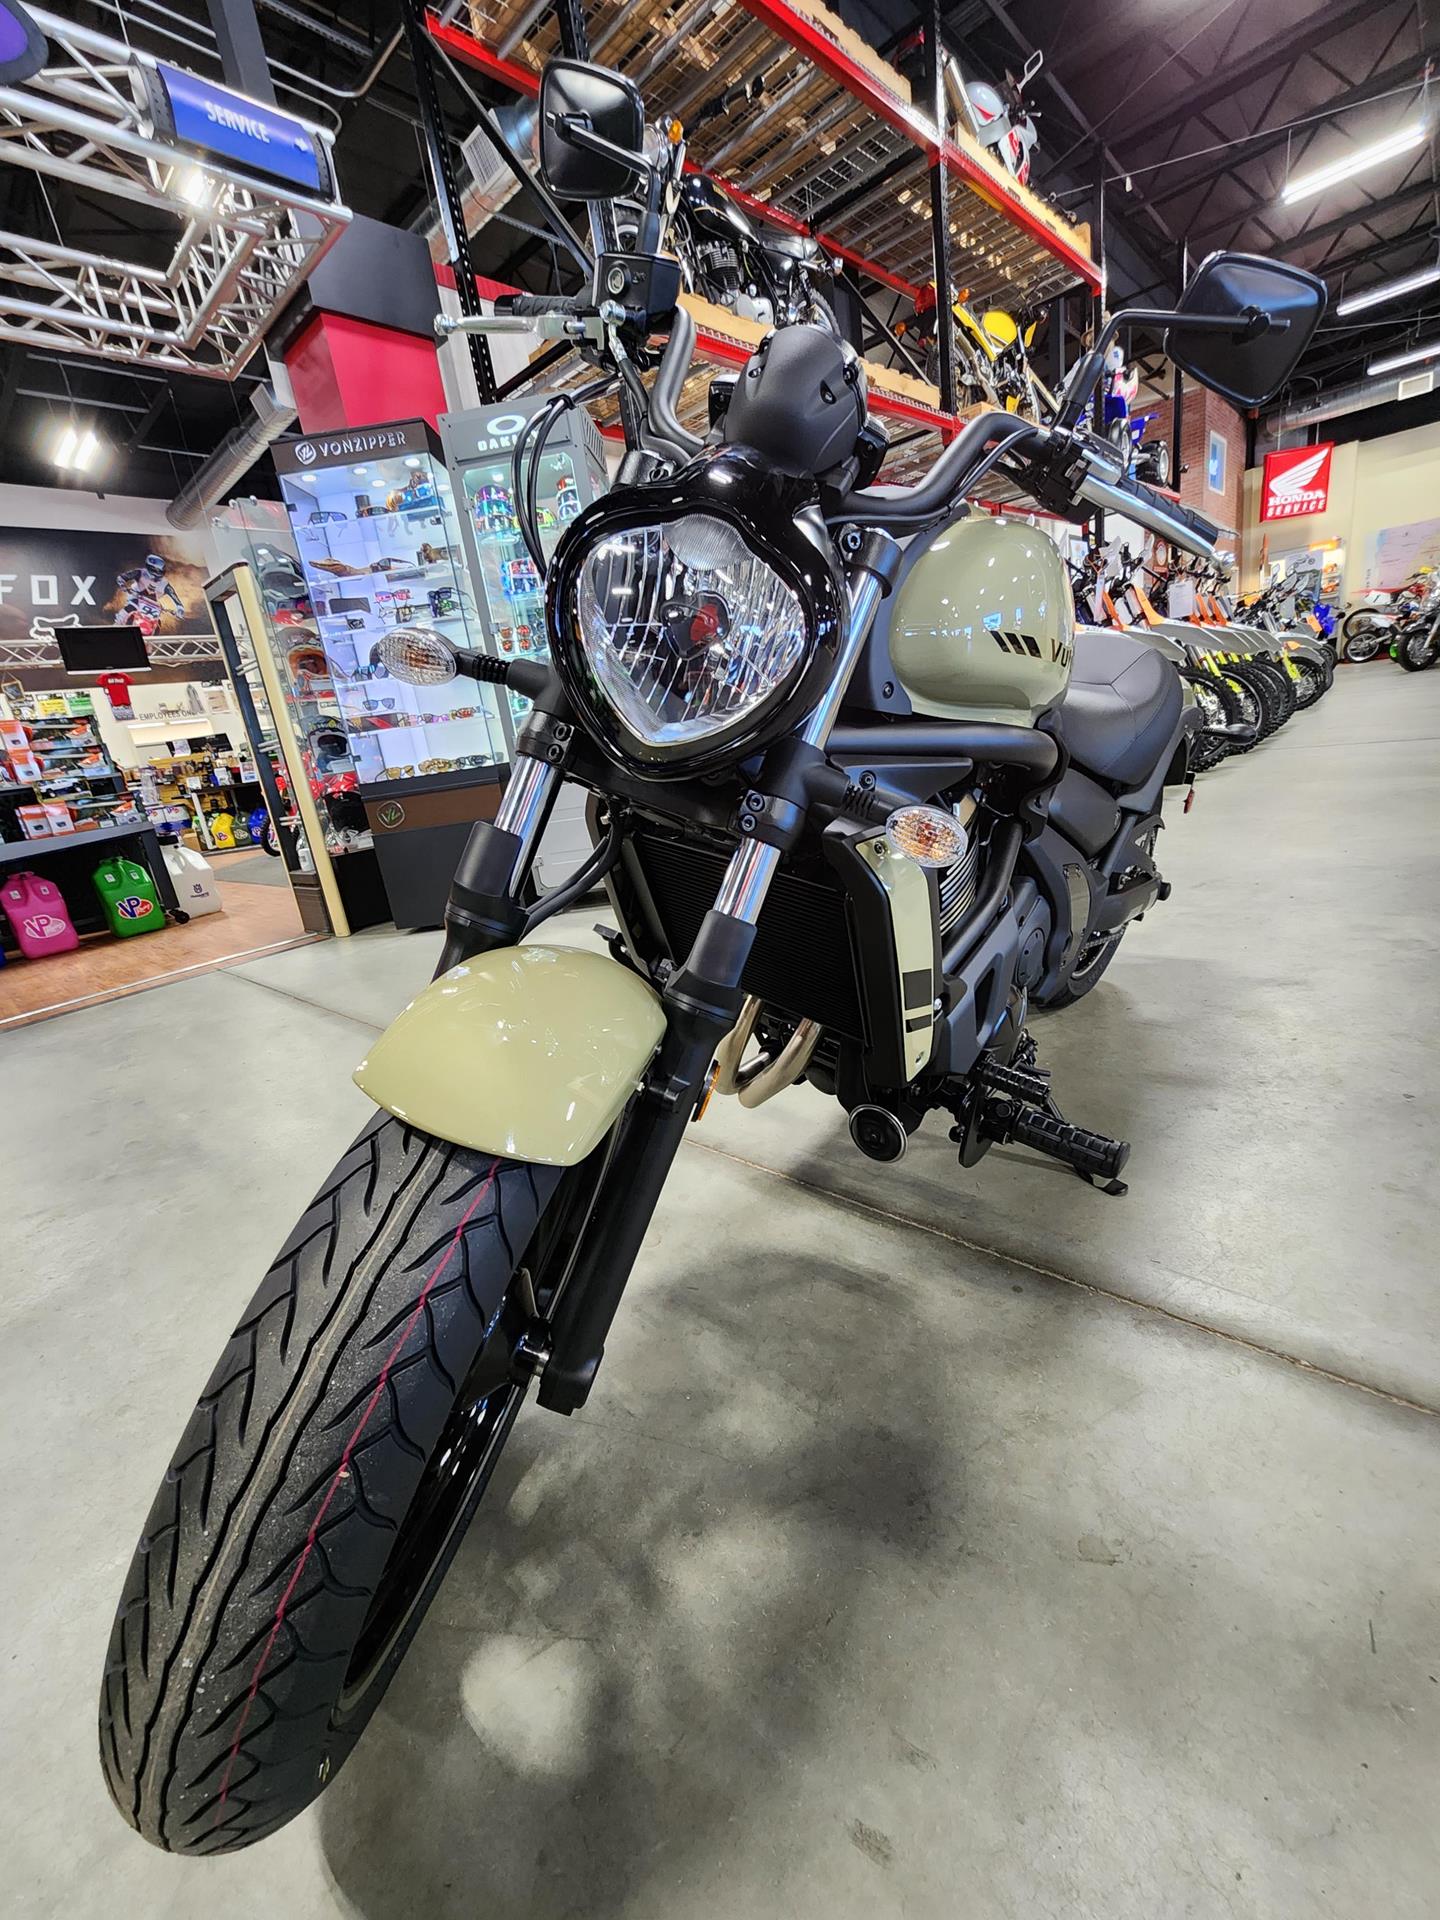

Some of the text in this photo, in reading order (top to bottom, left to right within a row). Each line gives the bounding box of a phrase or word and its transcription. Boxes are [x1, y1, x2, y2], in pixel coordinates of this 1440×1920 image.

[204, 100, 271, 144] SERVICE
[319, 431, 406, 457] VONZIPPER
[1266, 499, 1325, 517] SERVICE
[1268, 489, 1326, 507] HONDA
[0, 574, 97, 606] FOX
[139, 710, 180, 721] EMPLOYEES
[116, 896, 141, 919] VP
